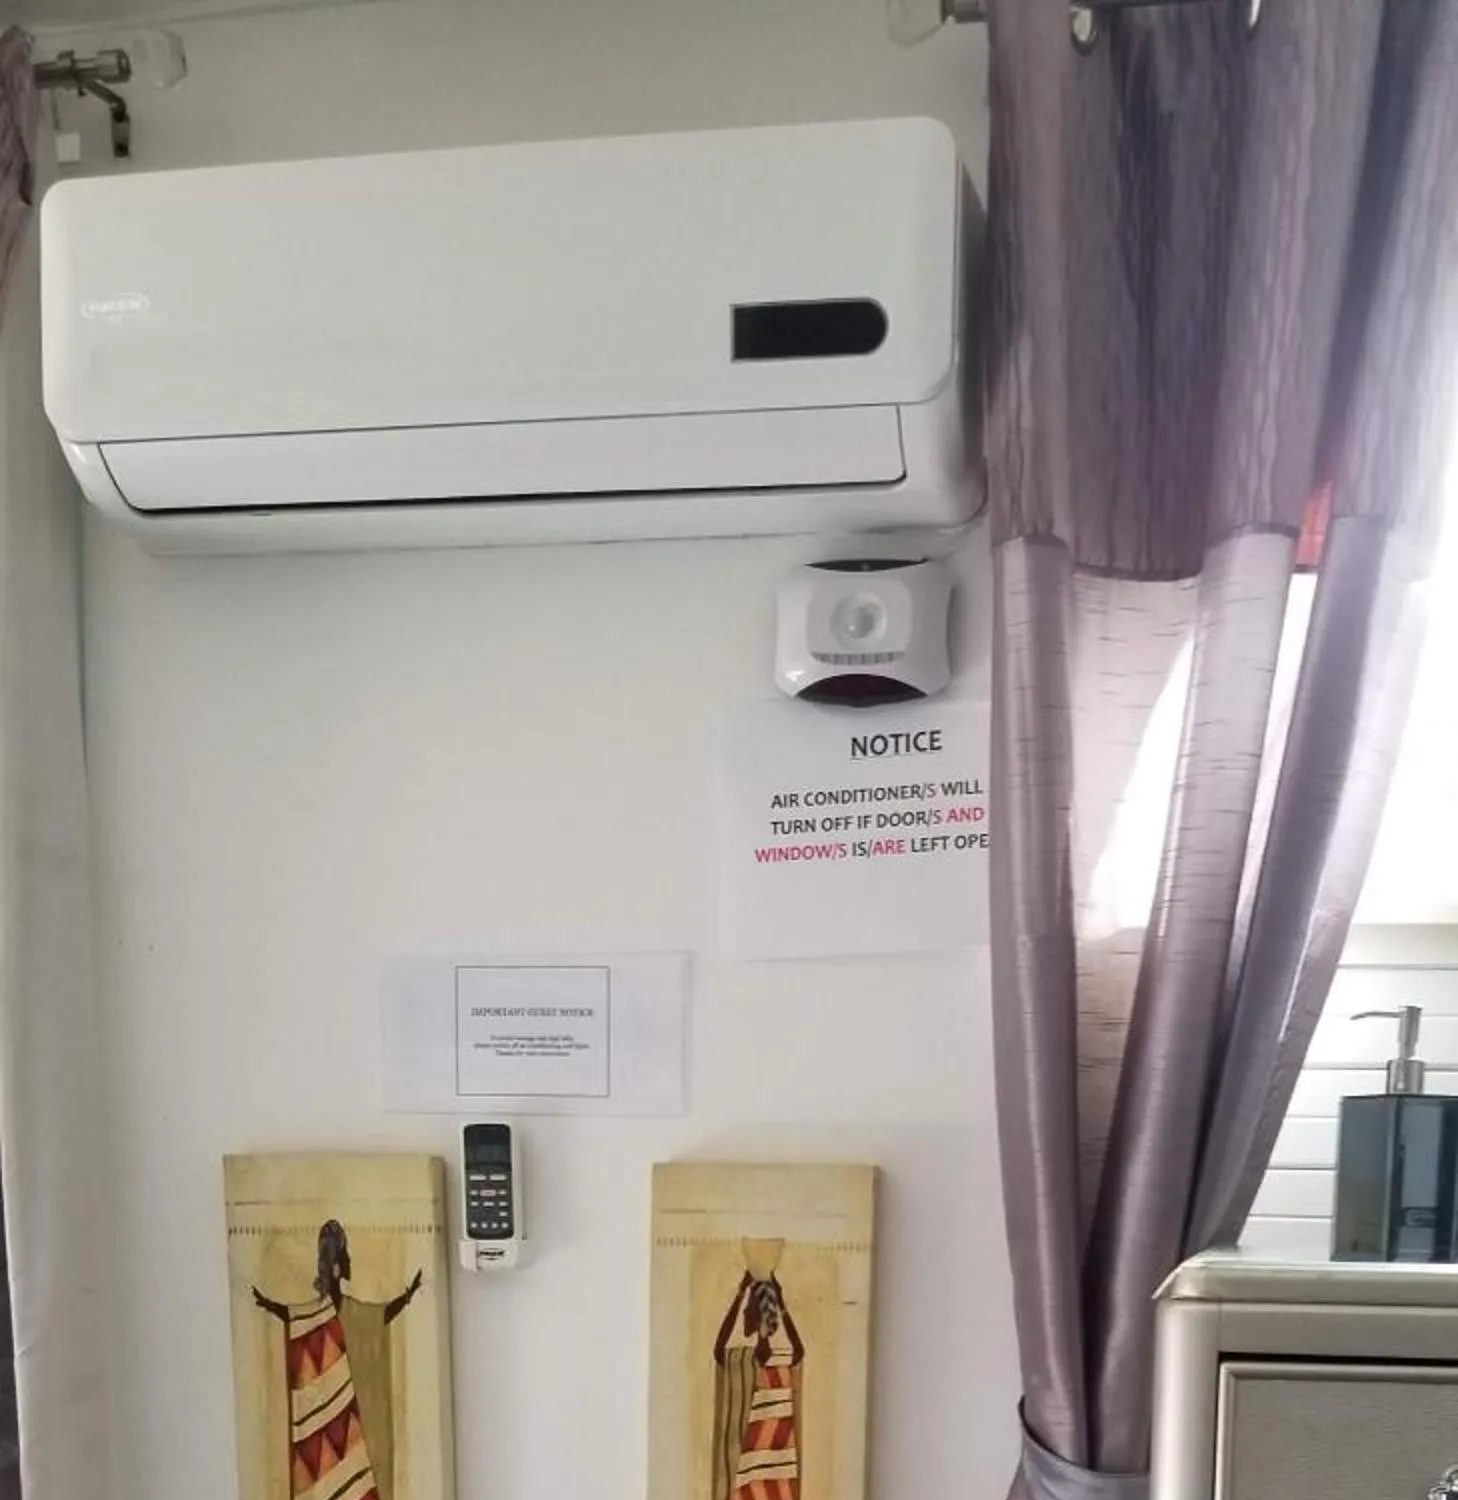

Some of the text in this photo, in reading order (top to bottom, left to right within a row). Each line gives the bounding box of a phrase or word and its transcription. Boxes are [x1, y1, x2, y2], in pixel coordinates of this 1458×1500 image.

[851, 730, 943, 757] NOTICE
[771, 778, 984, 809] AIR CONDITIONER/S WILL
[771, 807, 985, 835] TURN OFF IF DOOR/S AND
[755, 833, 989, 863] WINDOW/S IS/ARE LEFT OPE
